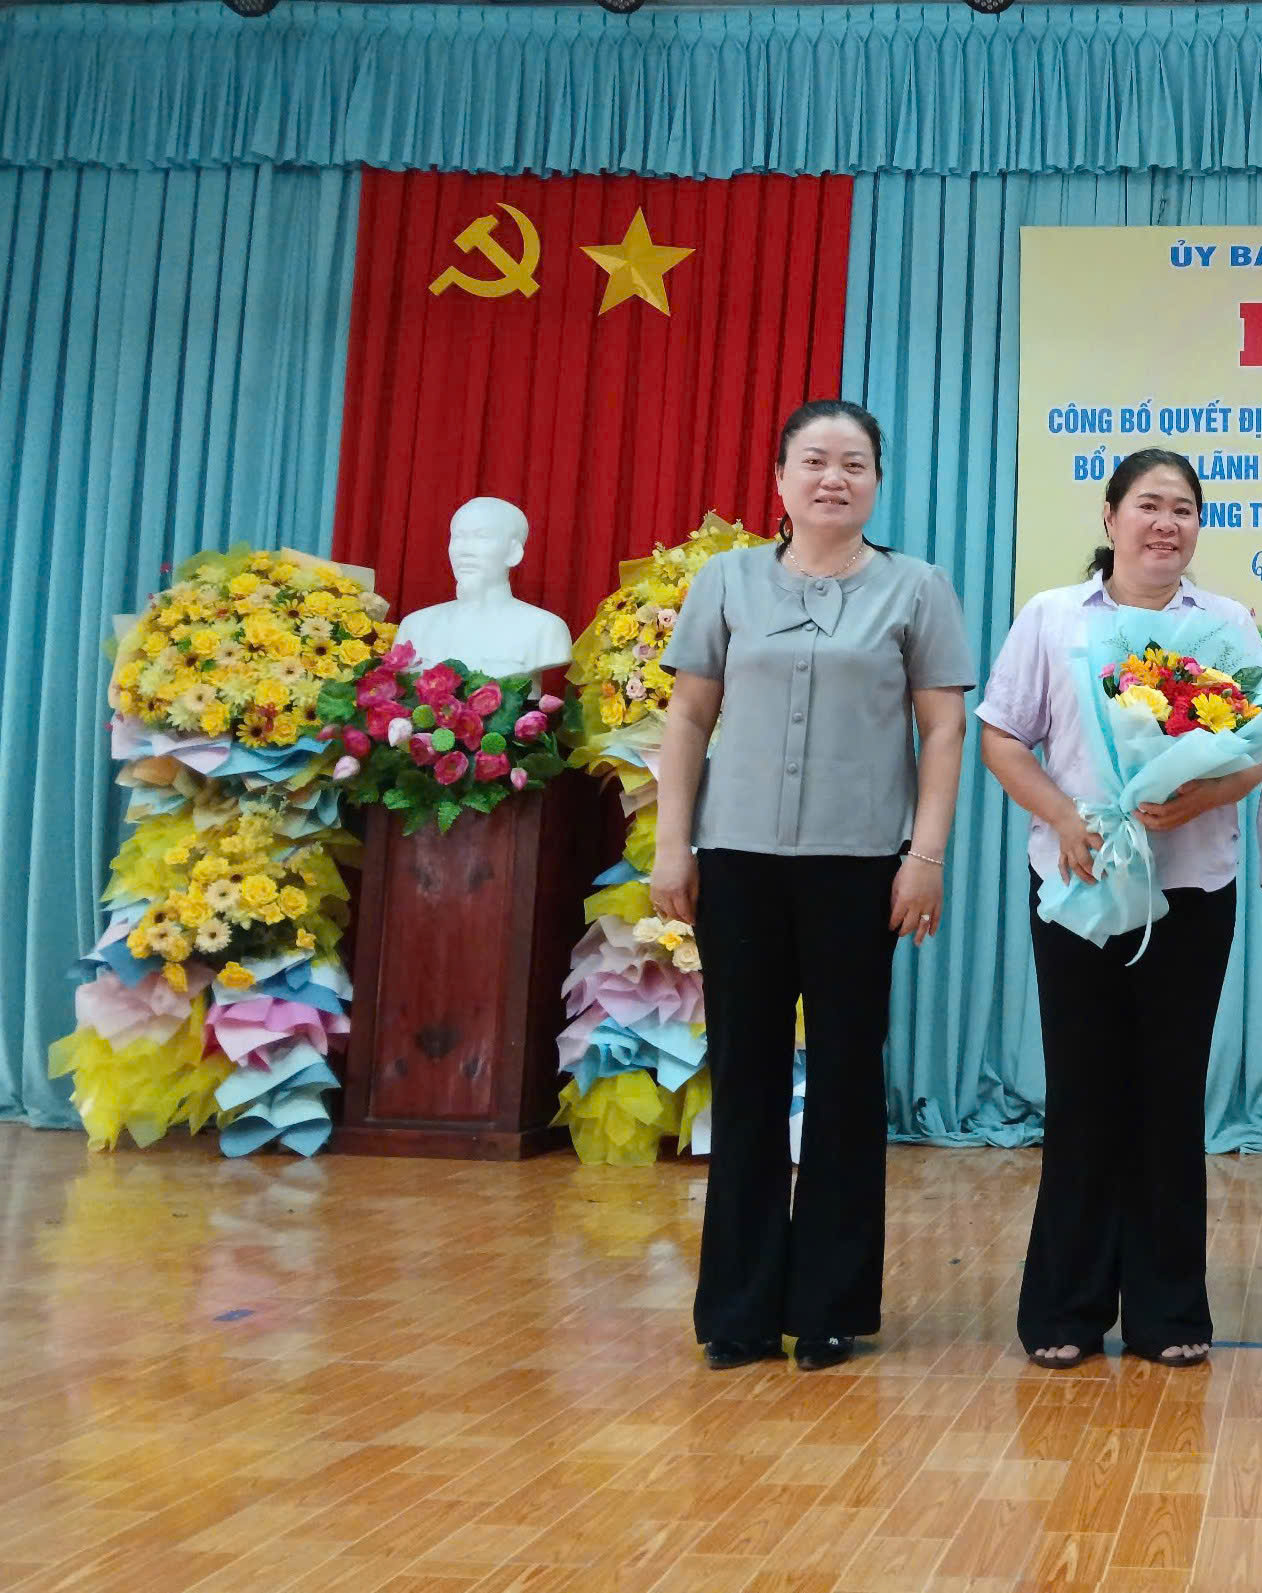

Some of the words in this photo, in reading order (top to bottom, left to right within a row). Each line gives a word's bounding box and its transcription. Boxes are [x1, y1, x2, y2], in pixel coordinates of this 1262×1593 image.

[1170, 240, 1216, 267] ỦY
[1049, 403, 1112, 433] CÔNG
[1121, 399, 1152, 433] BỐ
[1160, 400, 1231, 436] QUYẾT
[1075, 445, 1106, 480] BỔ
[1198, 451, 1258, 480] LÃNH
